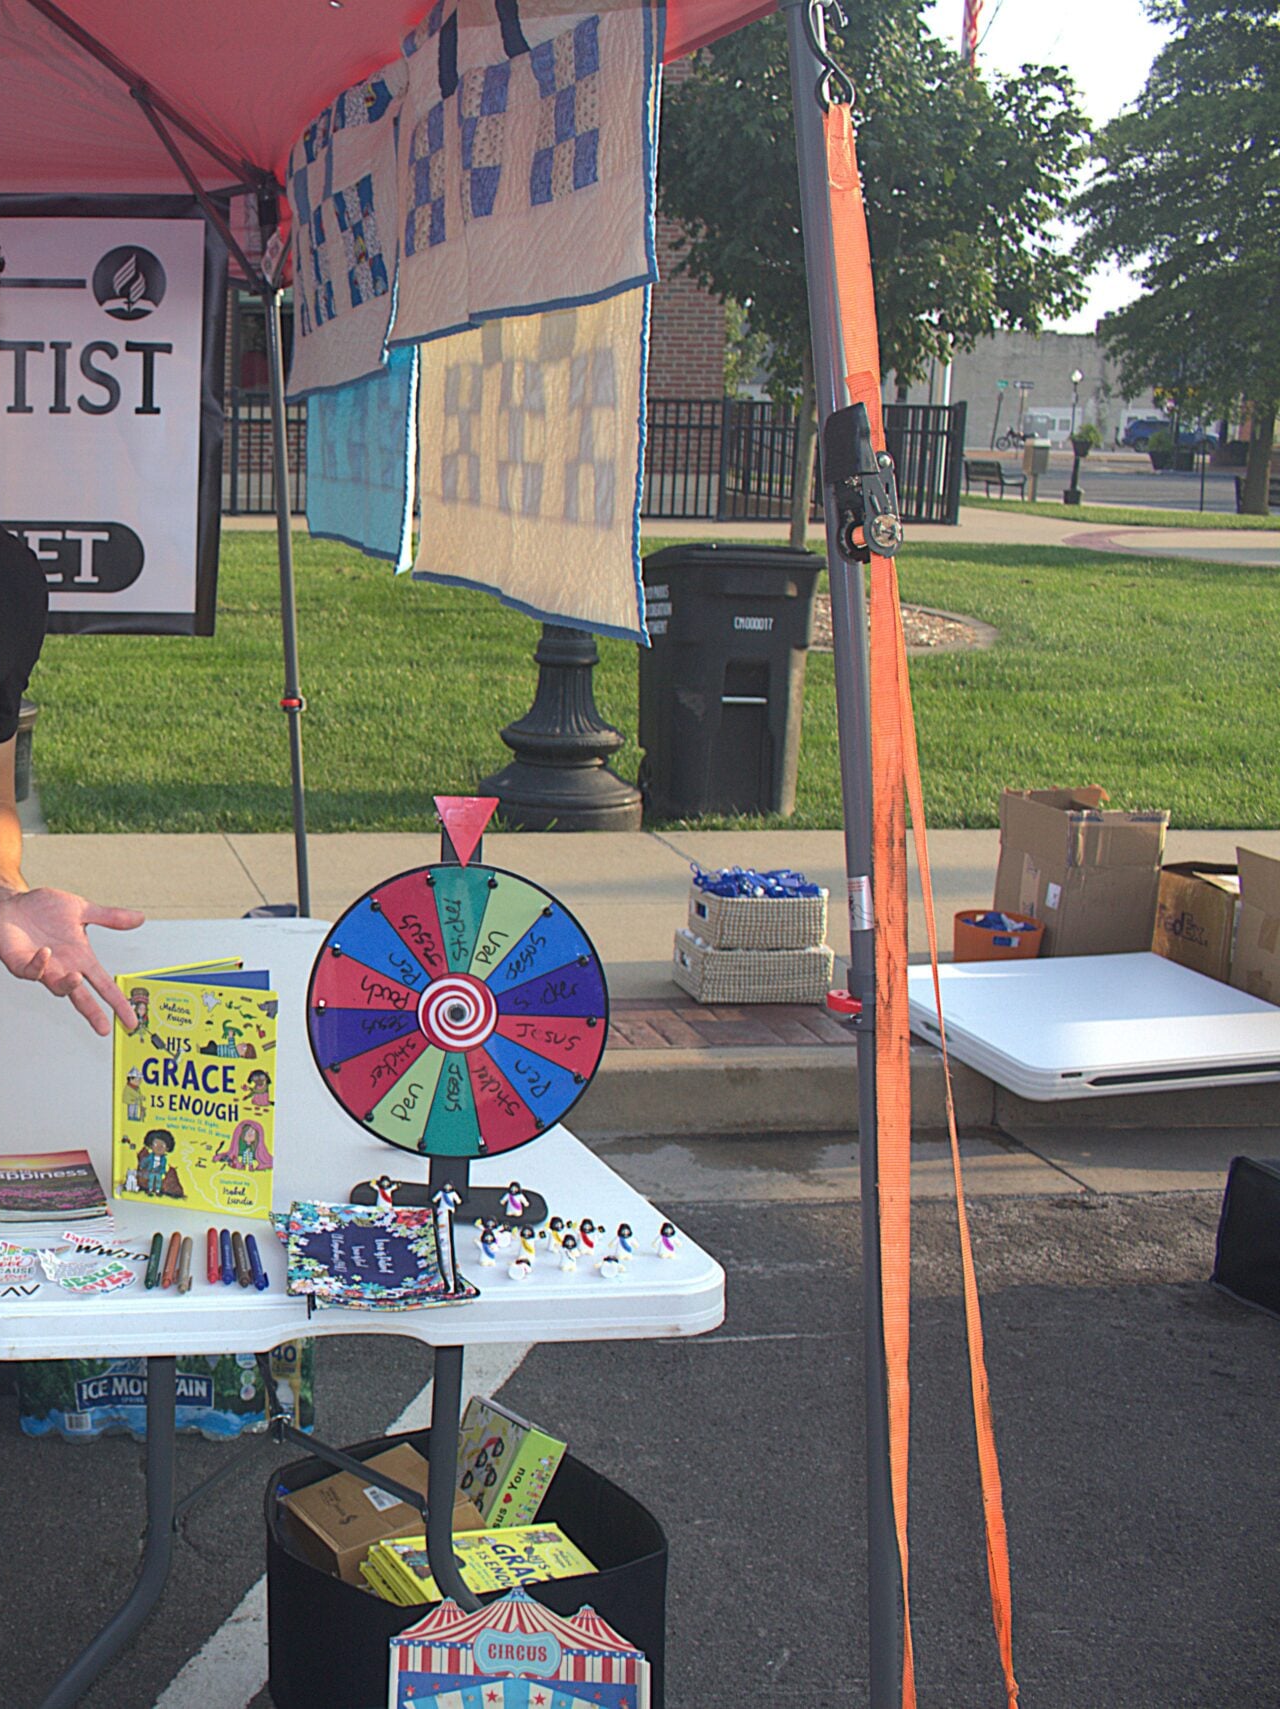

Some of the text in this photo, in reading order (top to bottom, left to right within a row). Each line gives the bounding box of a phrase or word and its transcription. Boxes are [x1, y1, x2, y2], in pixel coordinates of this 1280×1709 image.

[505, 932, 546, 981] Jesus
[360, 974, 410, 1012] Pouch
[160, 1003, 190, 1015] Melissa
[166, 1036, 193, 1053] HIS
[142, 1057, 236, 1094] GRACE
[444, 1062, 462, 1113] Jesus
[150, 1094, 239, 1122] IS ENOUGH
[390, 1082, 424, 1121] Pen
[75, 1244, 149, 1261] WWJD
[61, 1261, 124, 1288] JESUS
[272, 1345, 297, 1363] 40
[81, 1376, 207, 1400] ICE MOAIN
[507, 1467, 526, 1491] You
[487, 1643, 548, 1662] CIRCUS
